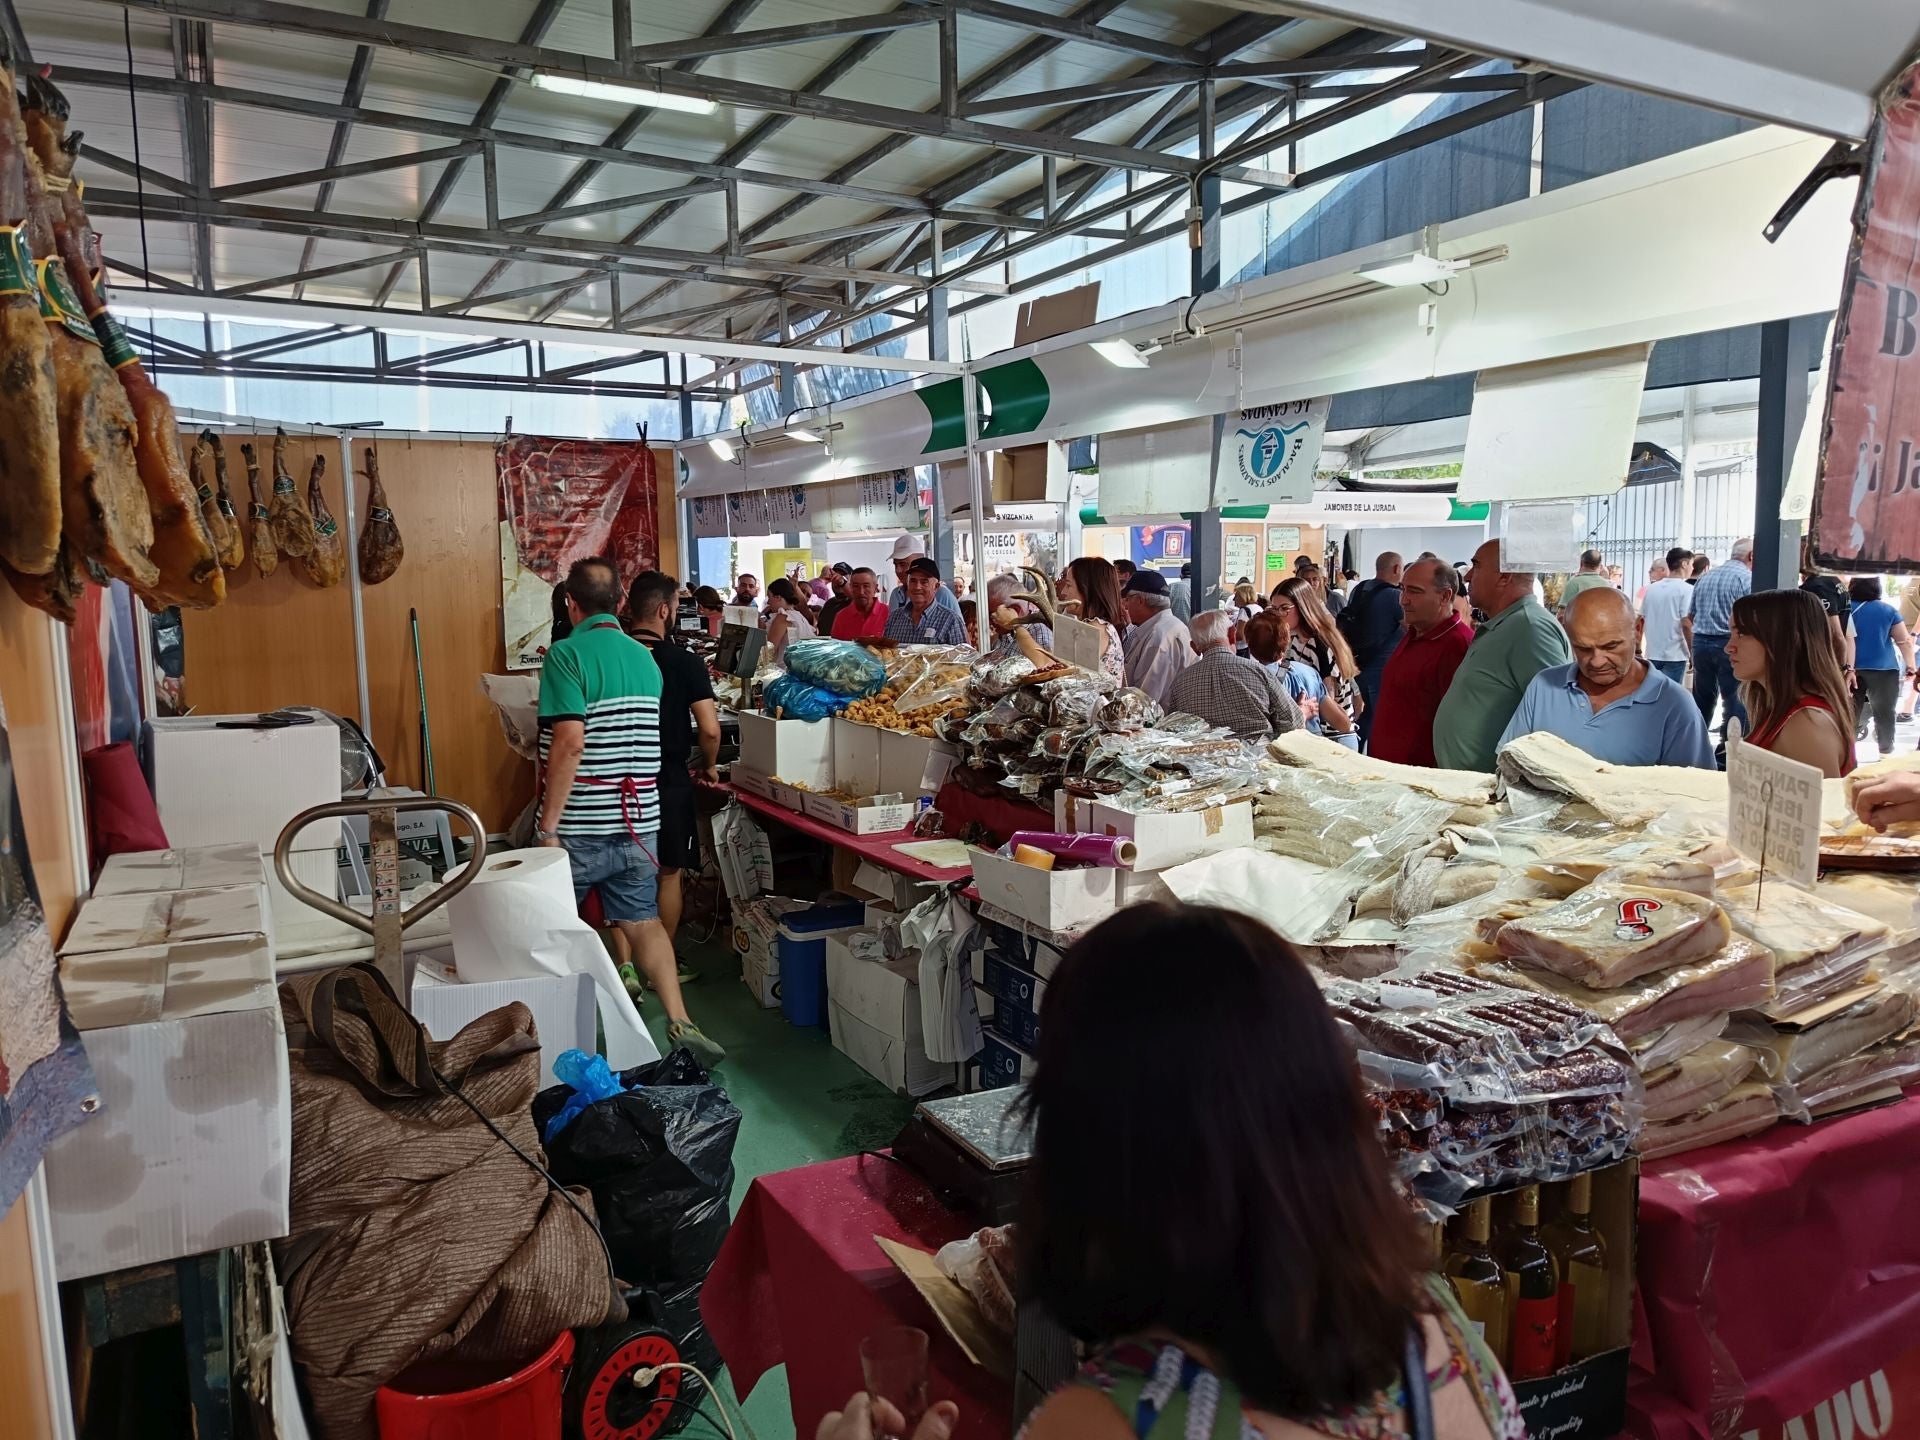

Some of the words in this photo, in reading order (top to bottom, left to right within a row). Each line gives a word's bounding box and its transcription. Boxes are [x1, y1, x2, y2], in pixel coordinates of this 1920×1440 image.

[1266, 438, 1303, 487] BACALAOS
[1324, 503, 1352, 511] JAMONES
[1353, 503, 1362, 511] DE
[1363, 504, 1371, 512] LA
[1372, 504, 1396, 512] JURADA
[984, 534, 1016, 548] PRIEGO
[1550, 1375, 1587, 1400] calidad
[1550, 1415, 1583, 1438] quality
